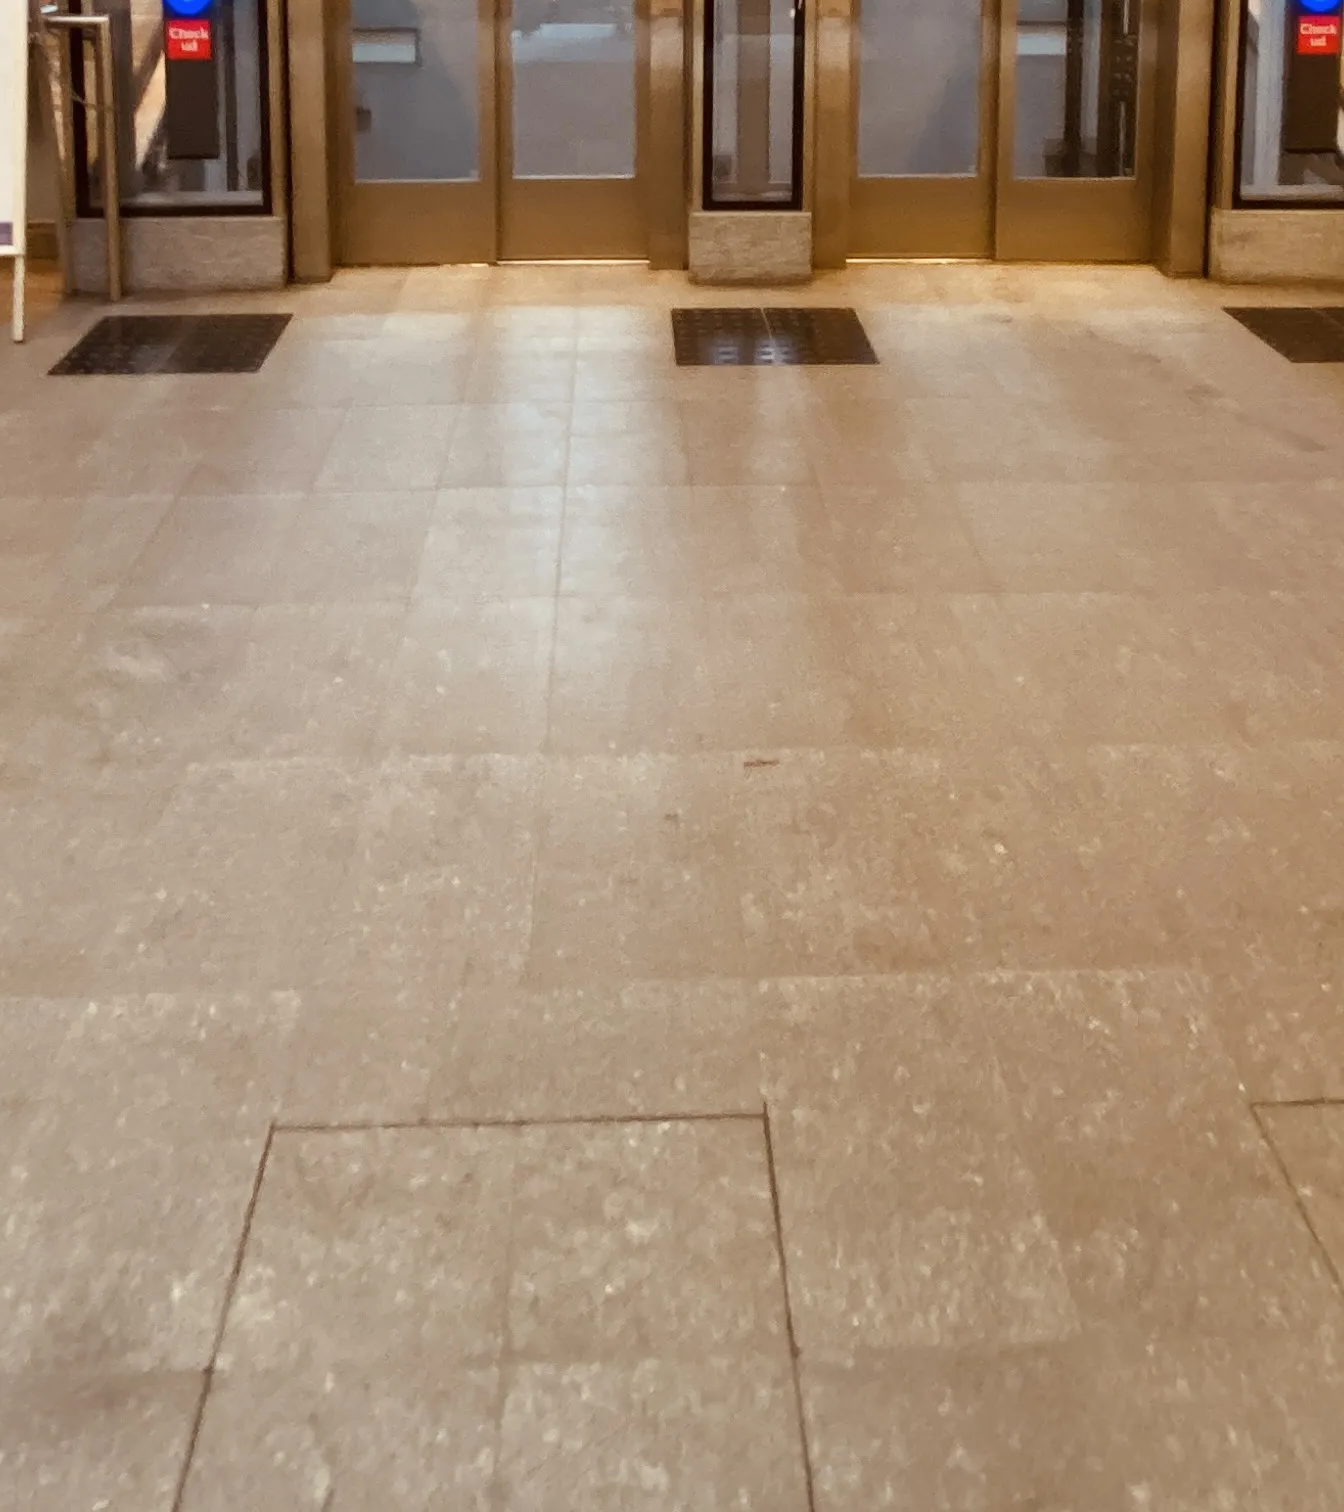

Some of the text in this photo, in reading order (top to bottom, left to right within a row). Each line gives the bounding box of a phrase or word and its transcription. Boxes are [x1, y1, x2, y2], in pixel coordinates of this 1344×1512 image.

[168, 27, 209, 39] Check
[1300, 23, 1337, 35] Check
[1310, 36, 1327, 47] ud
